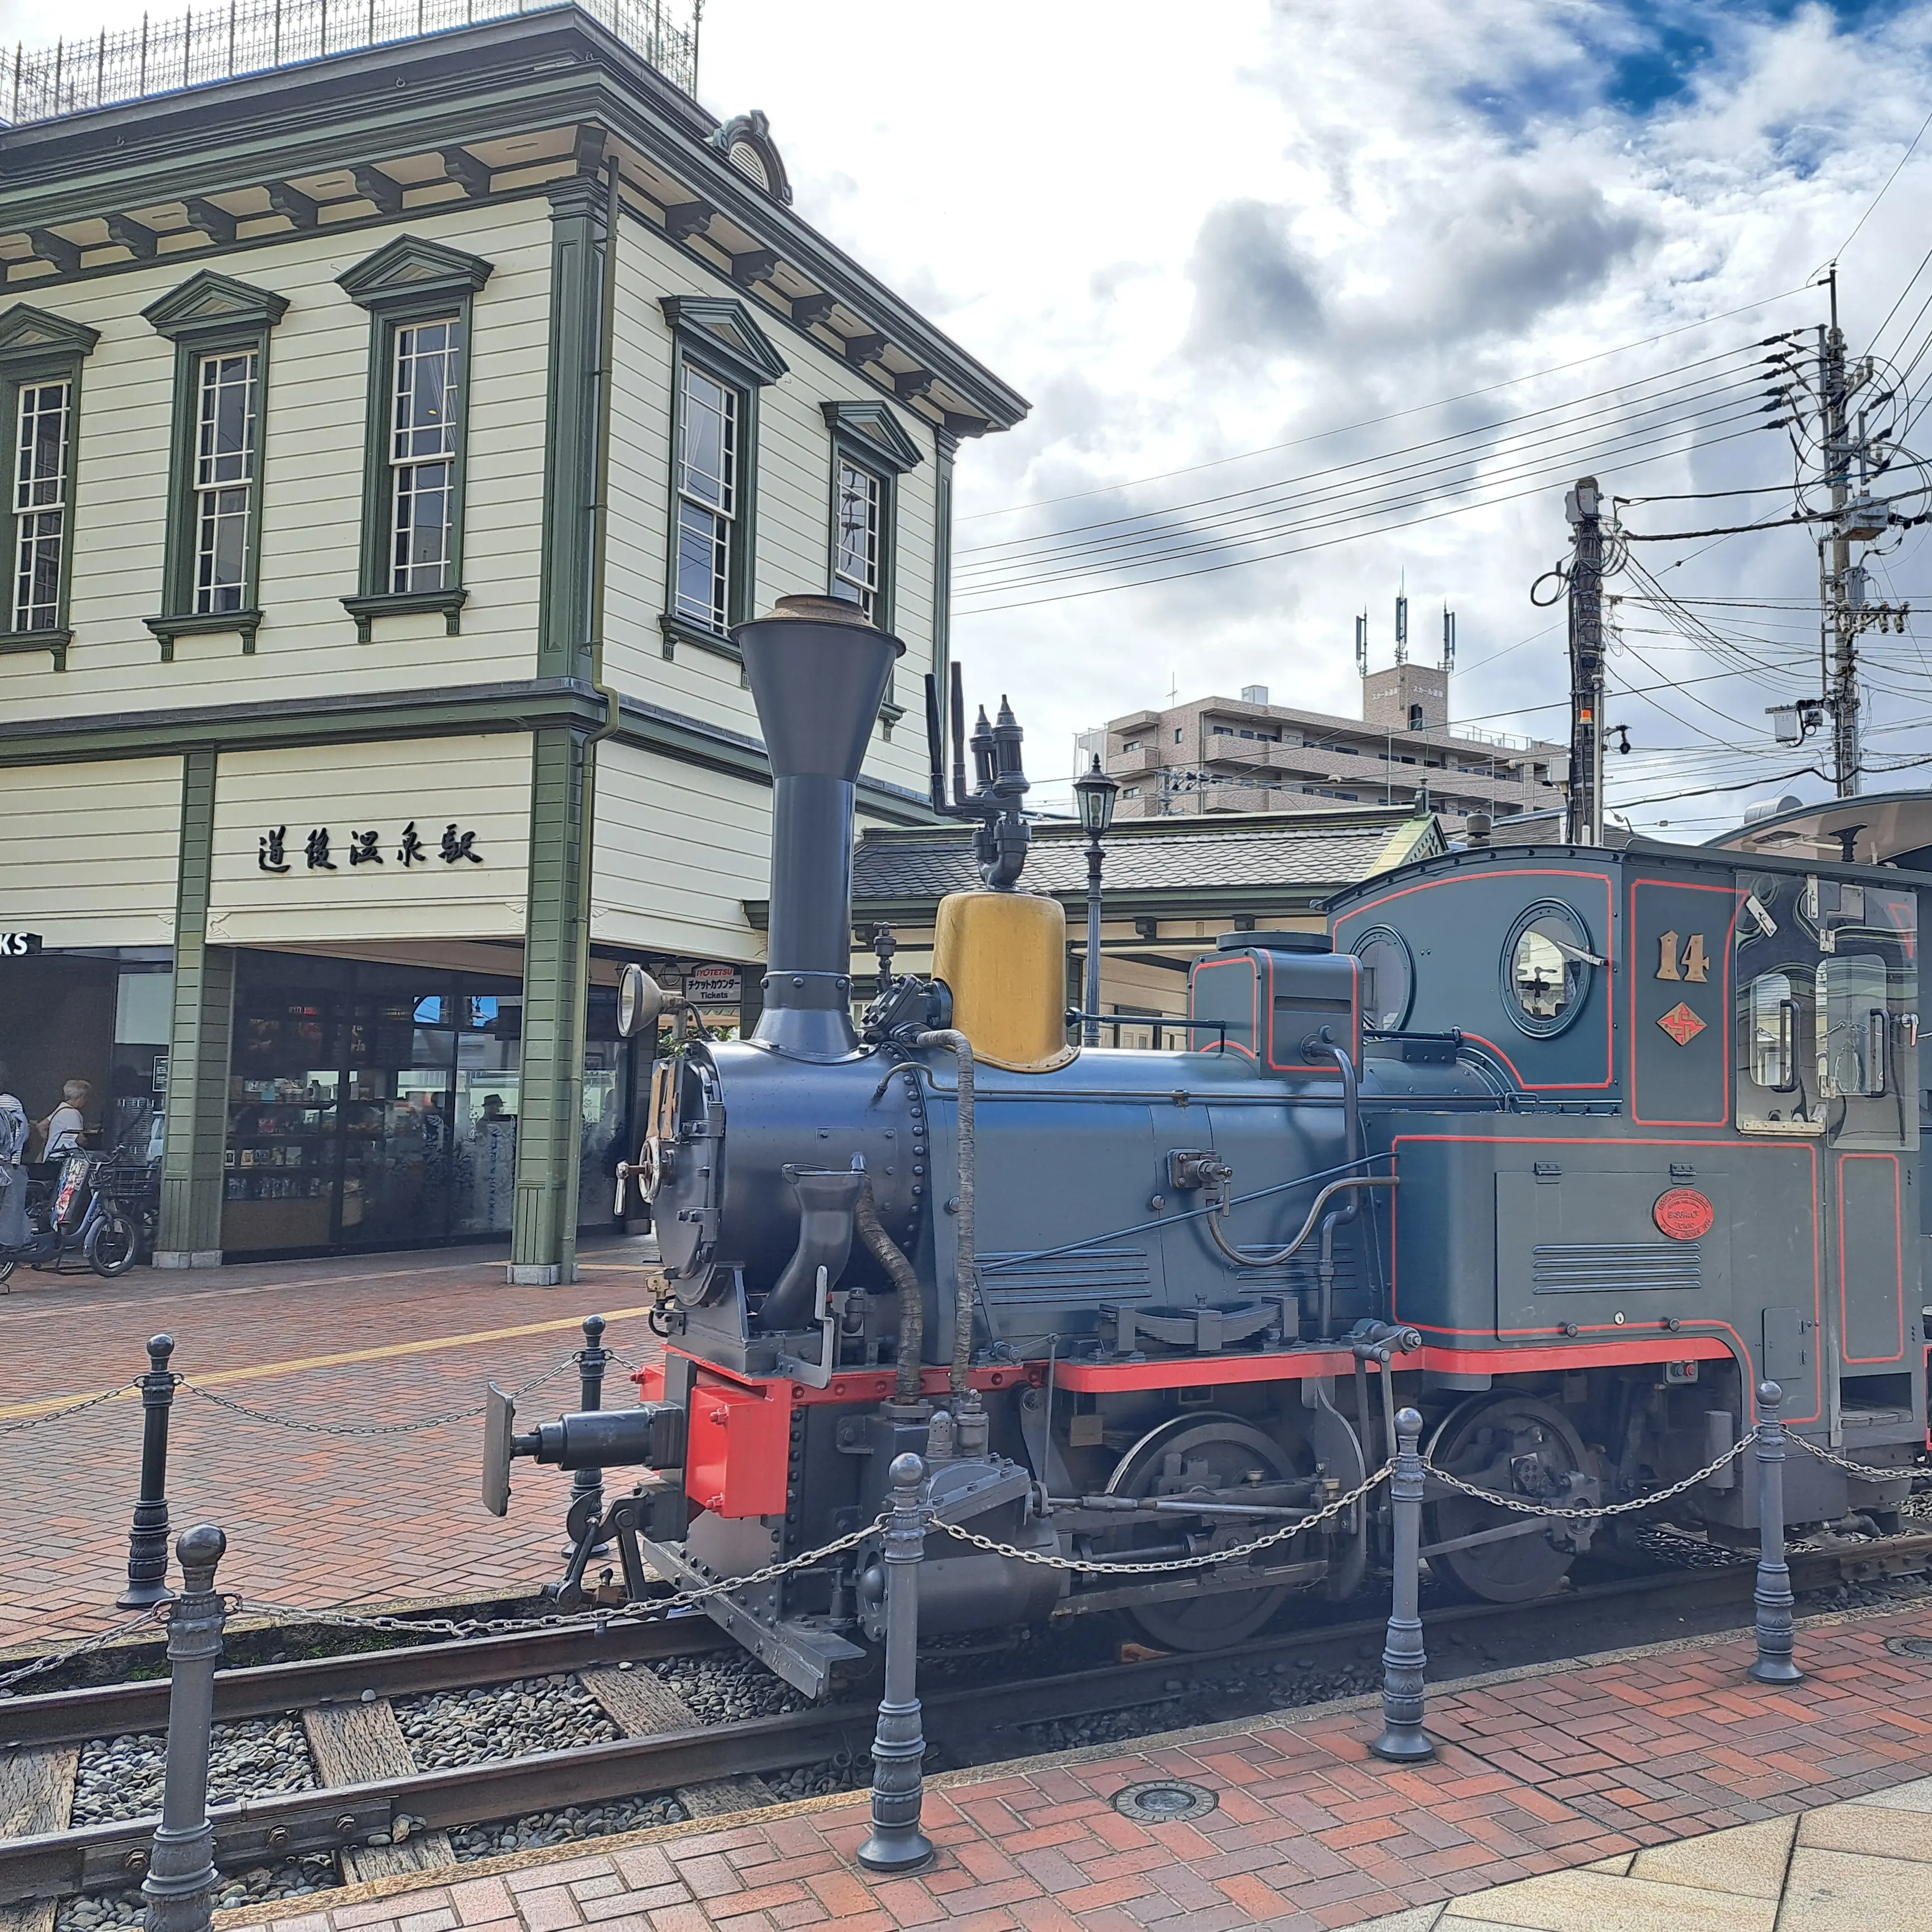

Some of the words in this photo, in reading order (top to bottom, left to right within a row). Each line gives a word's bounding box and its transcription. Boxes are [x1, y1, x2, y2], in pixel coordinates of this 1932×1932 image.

[259, 821, 484, 873] 道後温泉駅
[0, 932, 27, 955] KS
[1656, 930, 1709, 983] 14
[688, 979, 741, 991] チケットカウンター
[646, 1060, 678, 1139] 14
